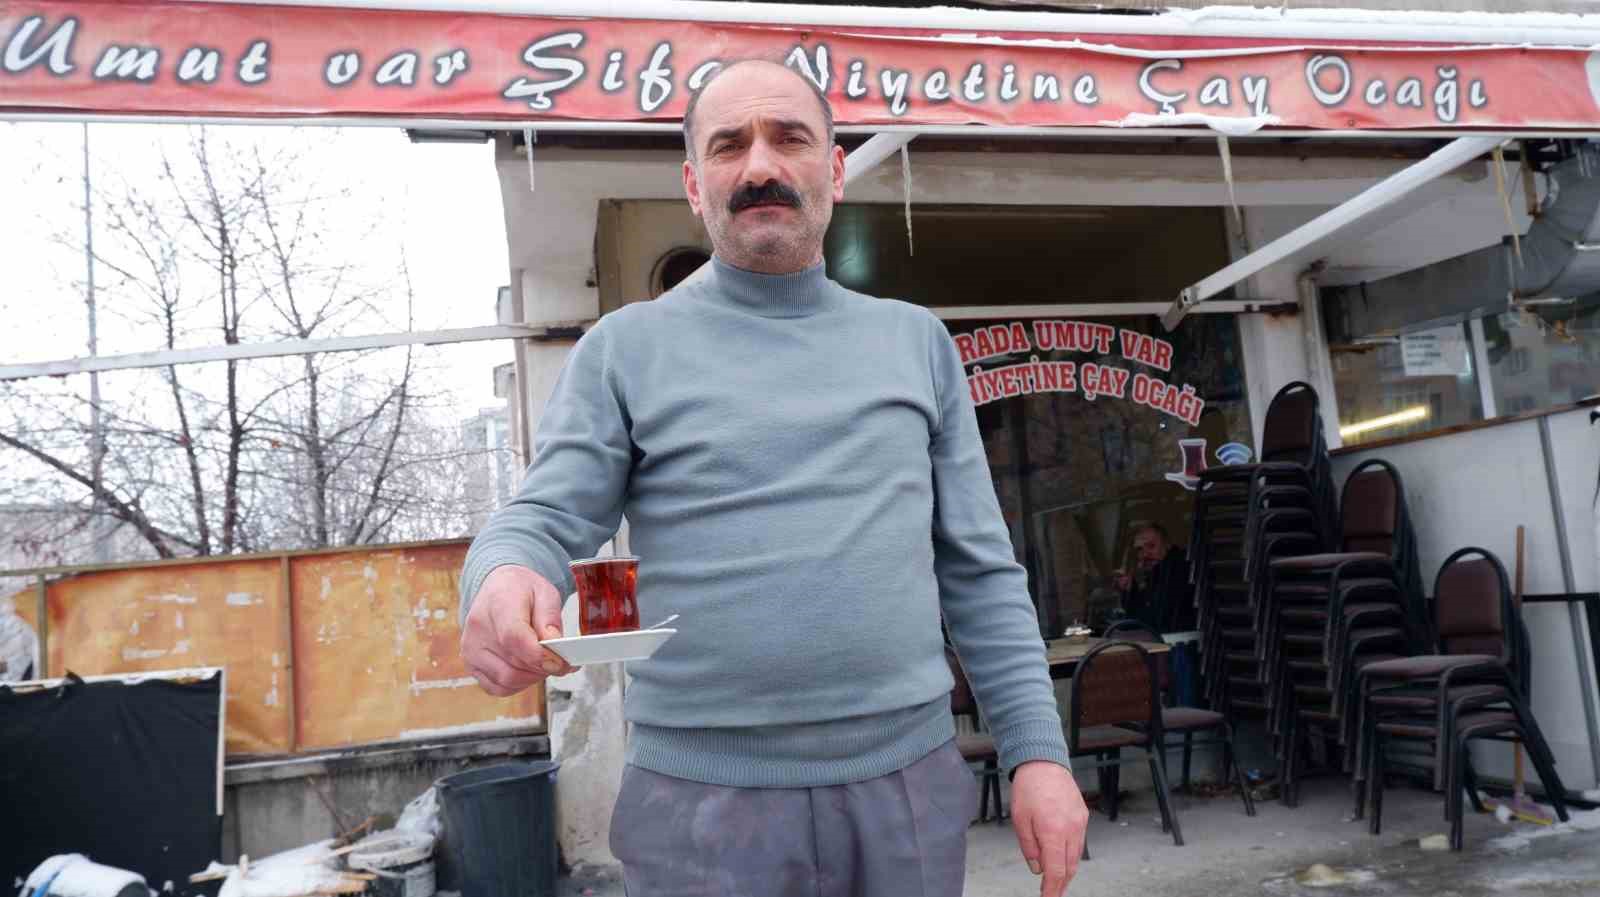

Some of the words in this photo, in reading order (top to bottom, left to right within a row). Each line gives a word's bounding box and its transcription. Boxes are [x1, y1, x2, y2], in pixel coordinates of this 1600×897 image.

[3, 16, 270, 83] Umut
[326, 50, 467, 84] var
[784, 45, 1098, 115] Niyetine
[1139, 59, 1269, 117] Çay
[1305, 54, 1487, 121] Ocağı
[1033, 320, 1114, 353] UMUT
[1120, 329, 1173, 372] VAR
[1081, 362, 1130, 401] ÇAY
[1132, 374, 1204, 426] OCAĞI
